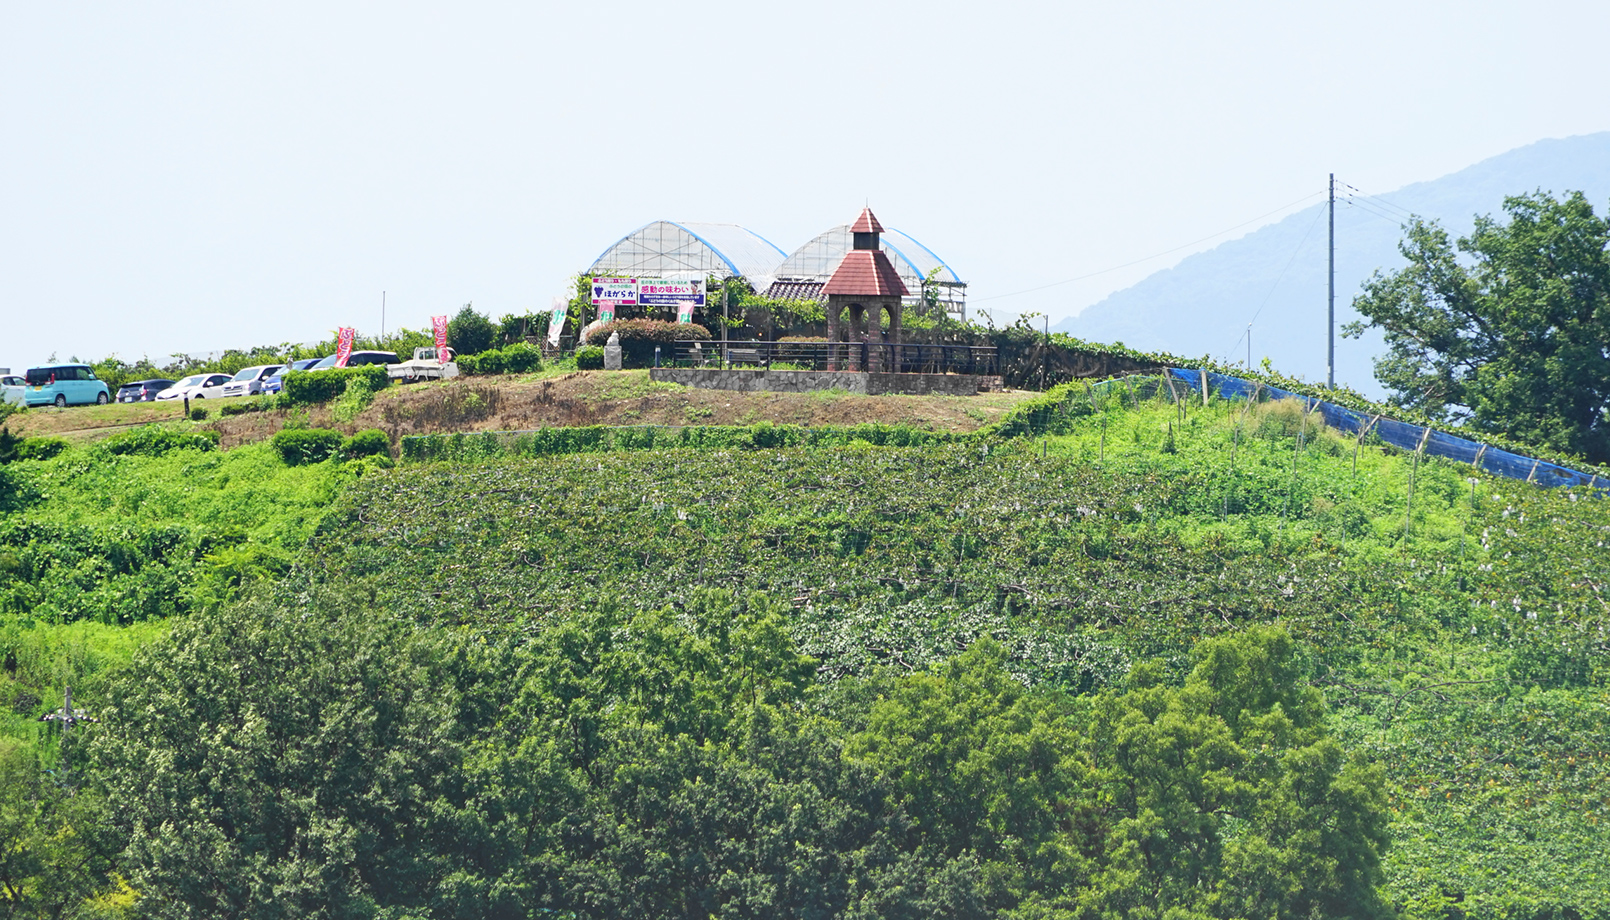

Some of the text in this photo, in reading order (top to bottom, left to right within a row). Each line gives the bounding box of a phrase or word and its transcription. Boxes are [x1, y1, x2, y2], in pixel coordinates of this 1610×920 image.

[641, 285, 689, 294] 感動の味わい
[604, 290, 636, 298] ほがらか
